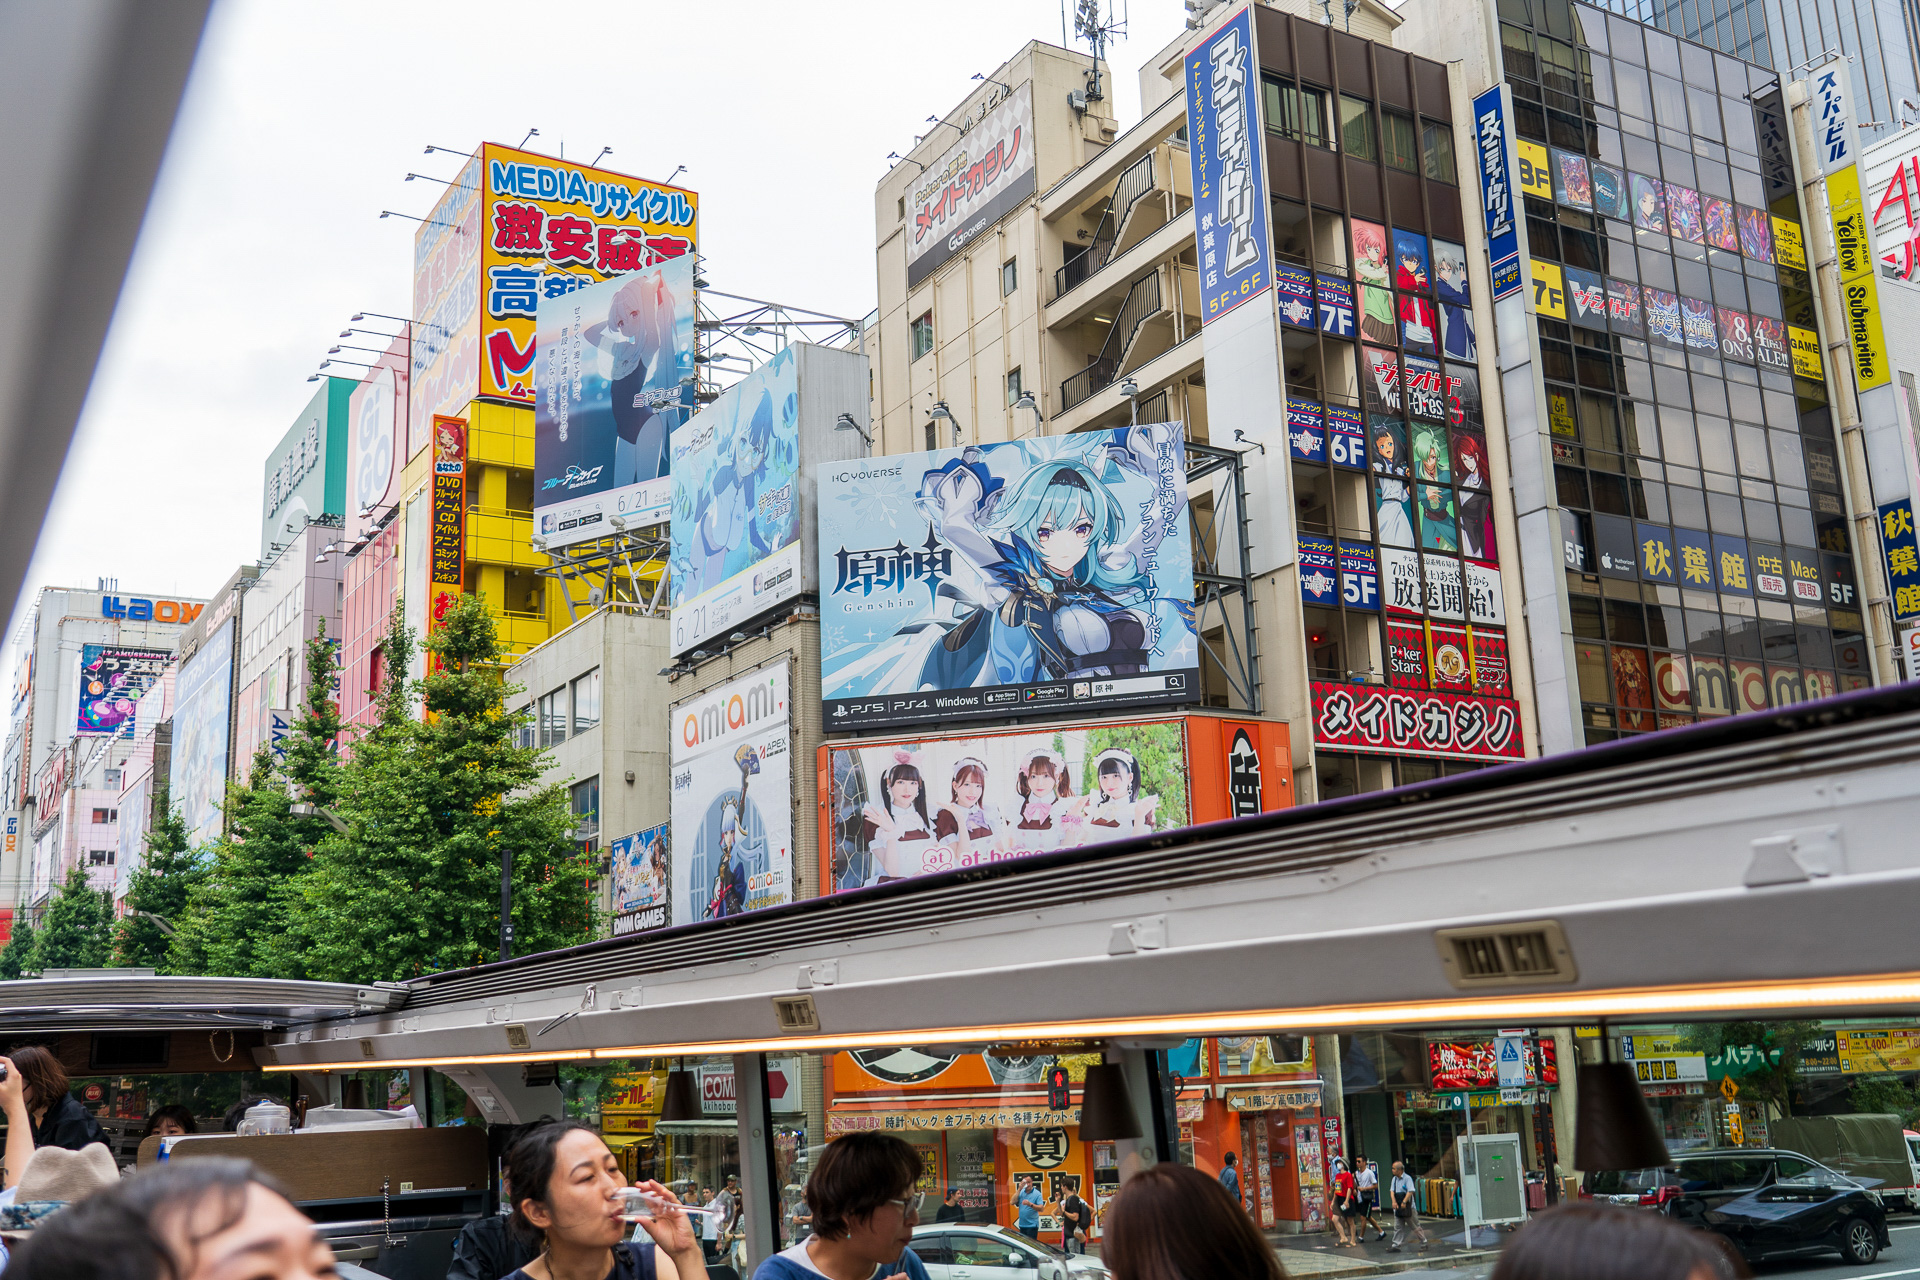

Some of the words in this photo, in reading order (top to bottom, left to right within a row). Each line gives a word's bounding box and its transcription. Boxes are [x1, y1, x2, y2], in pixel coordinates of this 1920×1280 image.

[1816, 70, 1847, 163] スーパービル
[1193, 70, 1209, 192] トレーディングカードゲーム
[489, 158, 694, 226] MEDIAリサイクル
[915, 125, 1022, 245] メイドカジノ
[1835, 216, 1860, 274] Yellow
[1856, 212, 1866, 240] HOBBY
[1862, 243, 1870, 266] BASE
[1201, 212, 1217, 290] 秋葉原店
[1494, 263, 1518, 280] 秋葉原店
[1320, 304, 1352, 335] 7F
[1847, 284, 1878, 381] Submarine
[1722, 338, 1744, 357] ON
[1790, 338, 1819, 354] GAME
[1554, 400, 1565, 413] 6F
[1331, 434, 1364, 465] 6F
[435, 462, 462, 473] あなたの
[437, 476, 461, 488] DVD
[1156, 441, 1178, 537] 冒険に満ちた
[435, 489, 461, 501] ブルーレイ
[618, 490, 647, 512] 6/21
[435, 500, 461, 512] ゲーム
[440, 512, 456, 523] CD
[435, 524, 460, 536] アイドル
[434, 536, 460, 548] アニメ
[435, 548, 459, 560] コミック
[1565, 540, 1585, 566] 5F
[1614, 557, 1635, 566] Authorized
[1882, 507, 1920, 617] 秋葉館
[436, 560, 458, 571] ホビー
[830, 520, 953, 615] 原神
[1642, 539, 1748, 590] 秋葉館
[1757, 555, 1783, 575] 中古
[1790, 560, 1818, 580] Mac
[434, 572, 458, 583] フィギュア
[1762, 576, 1783, 593] 販売
[1797, 581, 1818, 598] 買取
[1343, 573, 1376, 604] 5F
[1392, 577, 1496, 618] 放送開始!
[1830, 582, 1853, 604] 5F
[843, 597, 916, 614] Genshin
[677, 605, 706, 647] 6/21
[115, 650, 168, 661] AMUSEMENT
[1391, 659, 1422, 675] Stars
[850, 702, 884, 714] PS5
[894, 699, 928, 711] PS4
[936, 696, 979, 708] Windows
[1095, 683, 1114, 694] 原神
[683, 678, 775, 748] amiami
[1320, 691, 1514, 752] メイドカジノ
[766, 736, 787, 751] APEX
[929, 854, 945, 865] at
[748, 870, 784, 891] amiami
[613, 913, 634, 936] DMM
[634, 906, 665, 930] GAMES
[1638, 1061, 1677, 1079] 秋葉館
[1248, 1091, 1319, 1108] 1階にて高価買取中
[831, 1115, 881, 1130] 高価買取
[1325, 1119, 1338, 1130] 4F
[956, 1150, 987, 1162] 大黒屋
